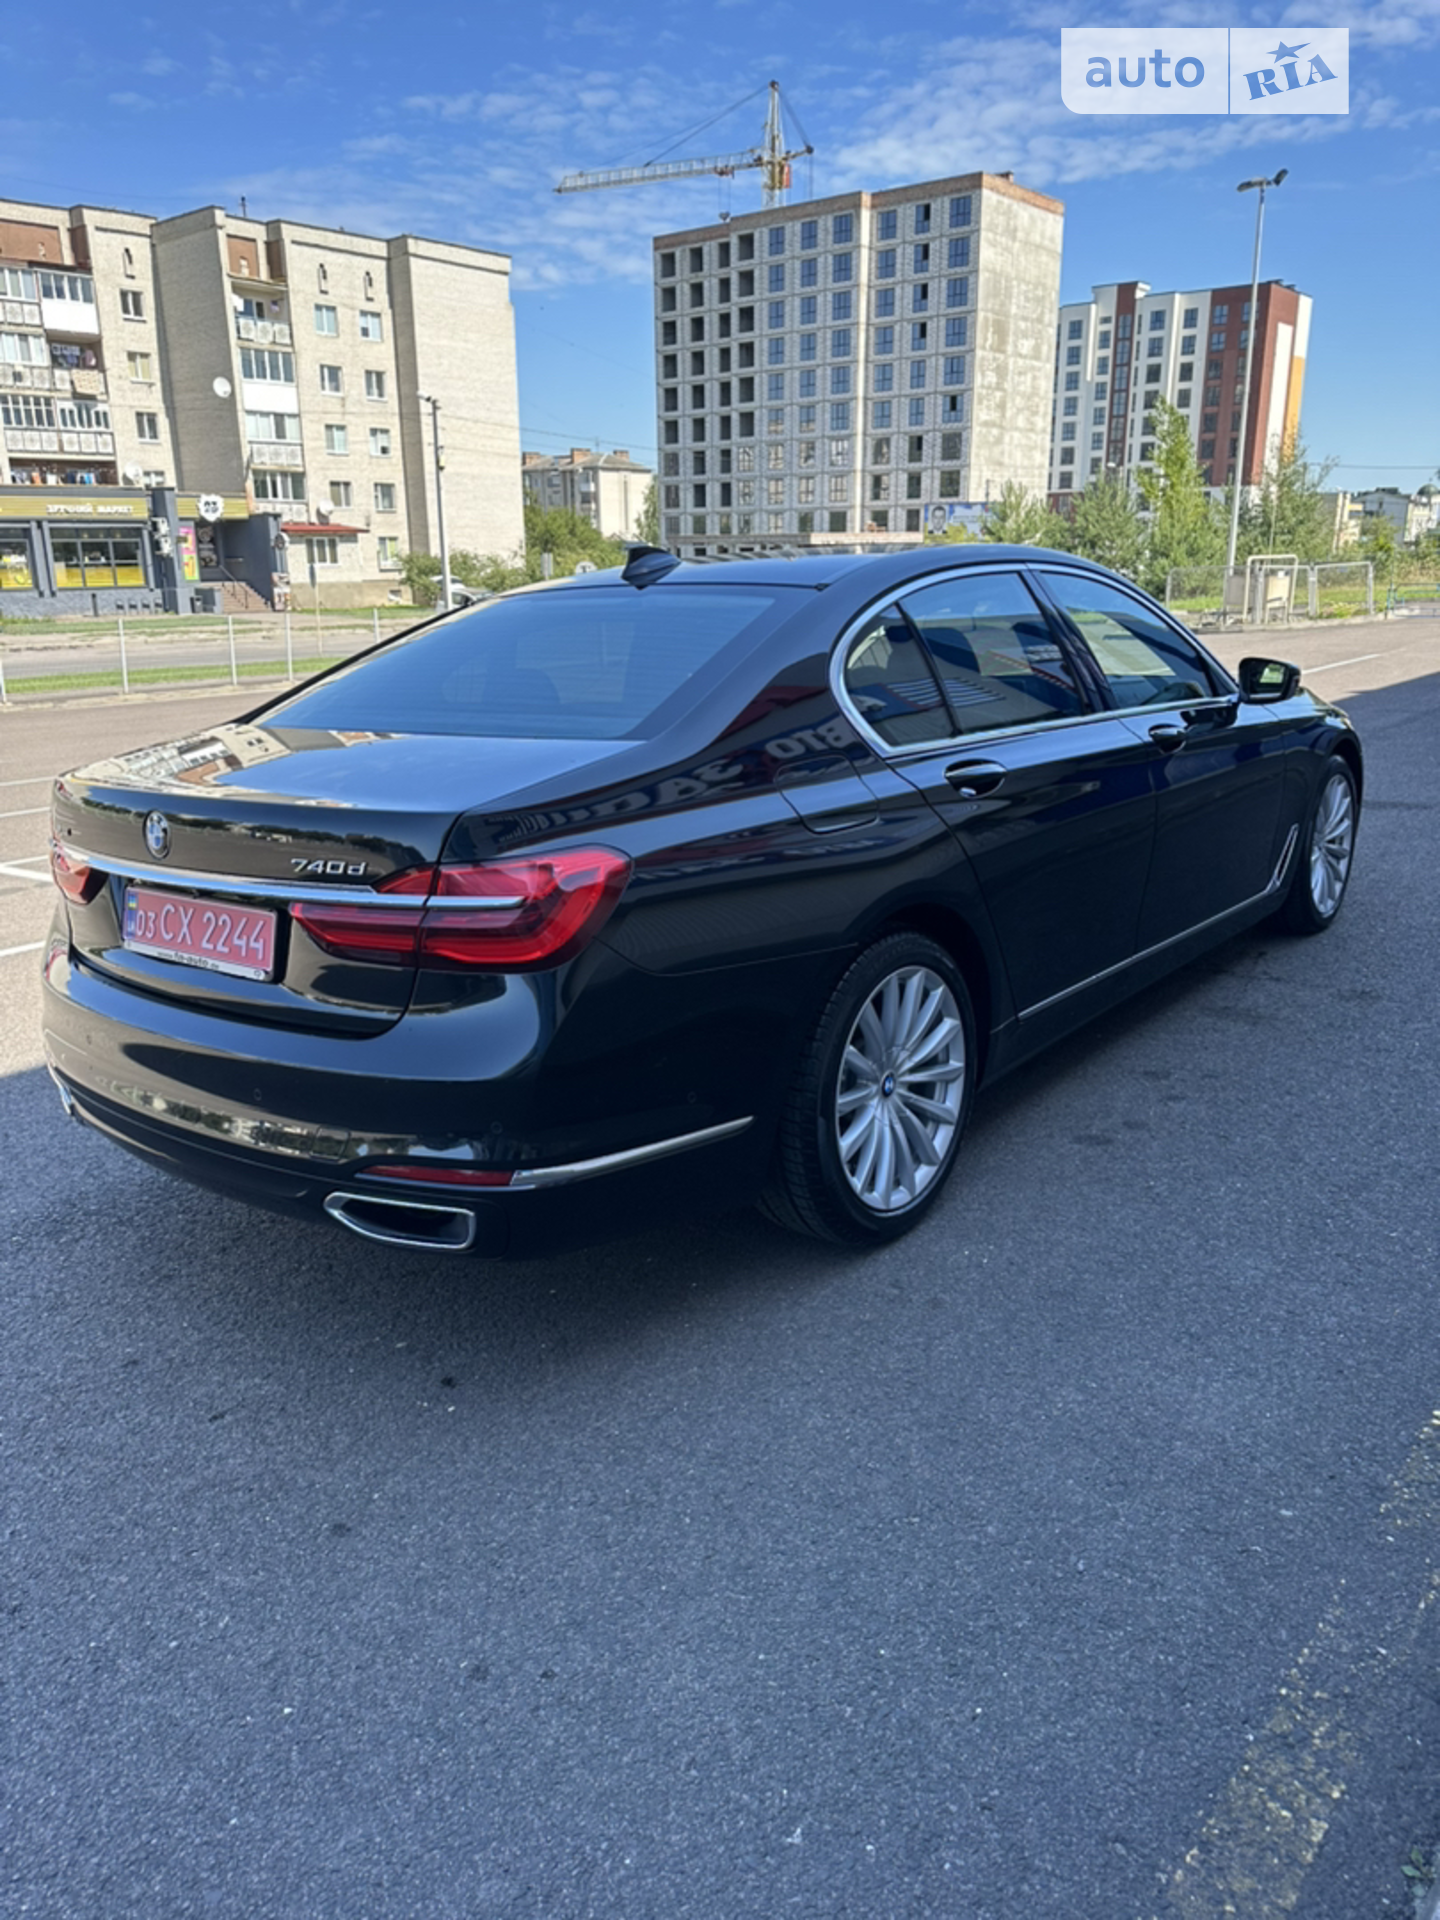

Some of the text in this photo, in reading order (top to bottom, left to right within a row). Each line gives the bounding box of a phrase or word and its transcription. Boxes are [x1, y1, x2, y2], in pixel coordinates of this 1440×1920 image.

[290, 857, 367, 876] 740d
[136, 910, 157, 939] 03
[202, 910, 267, 960] 2244
